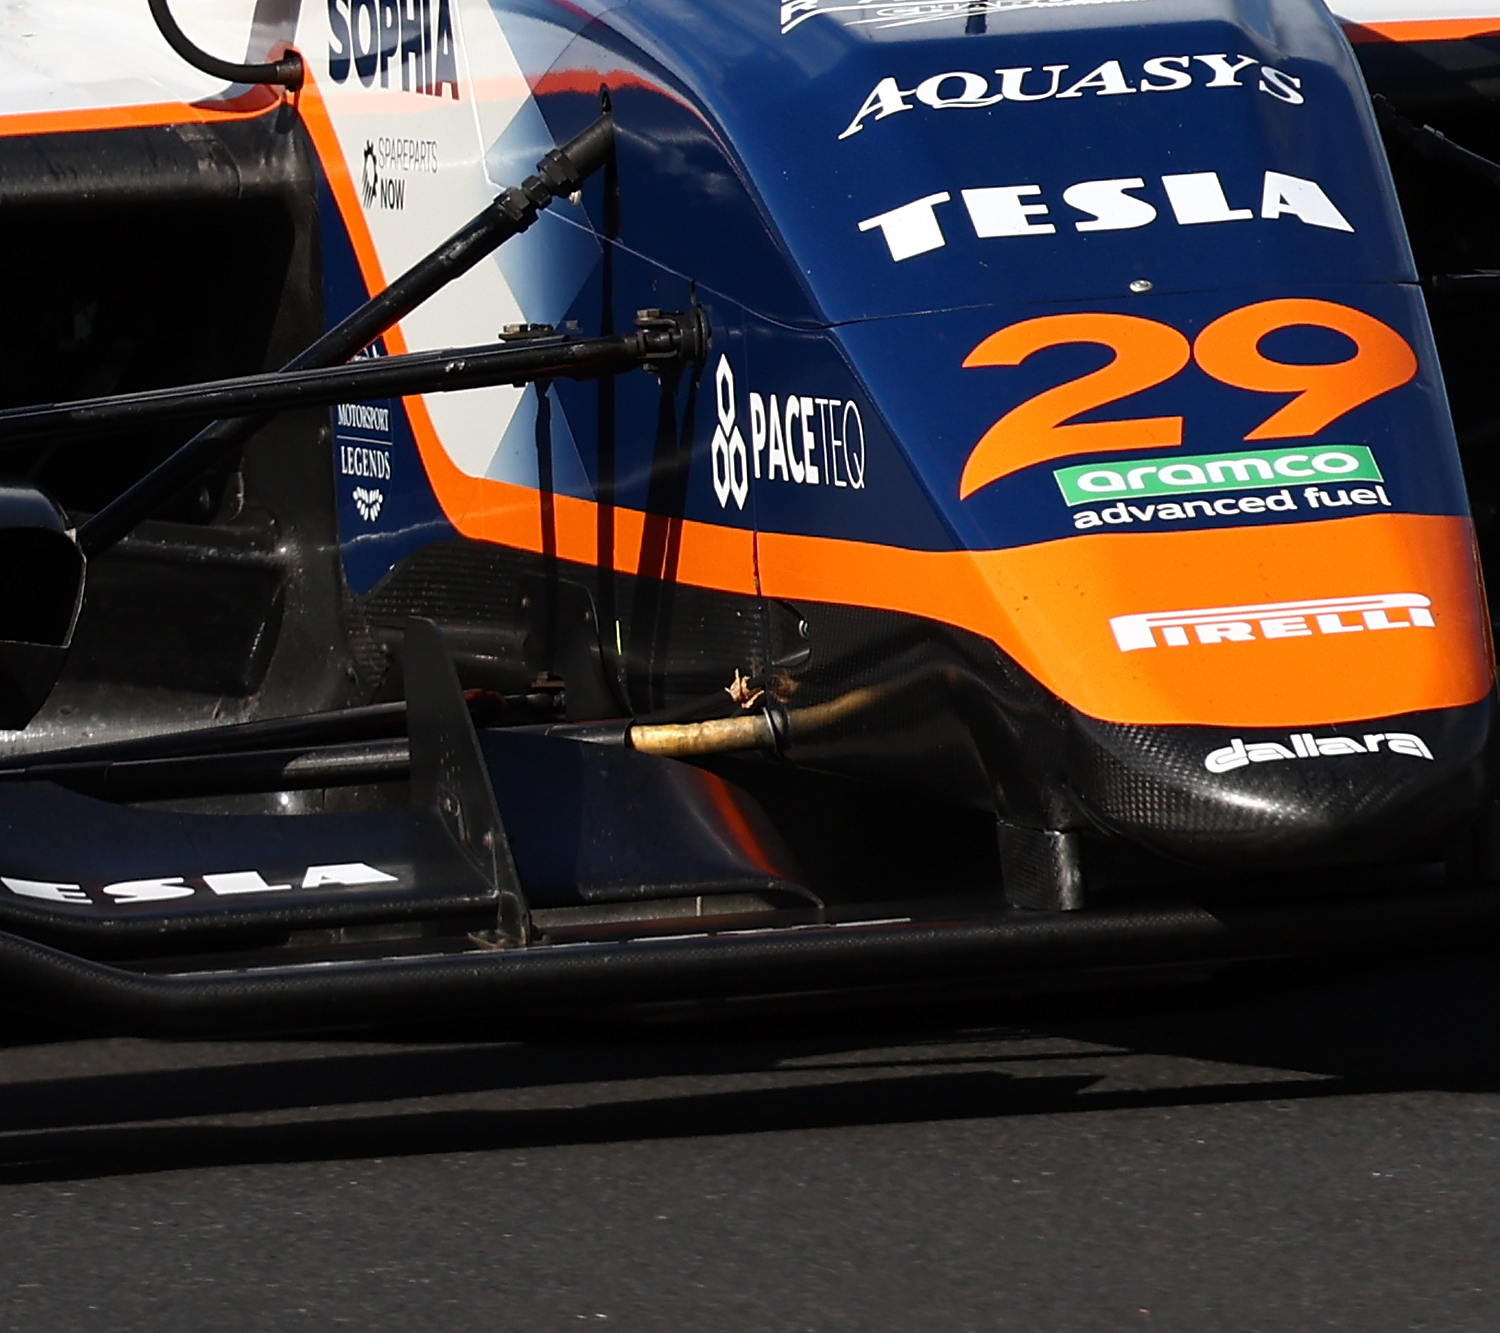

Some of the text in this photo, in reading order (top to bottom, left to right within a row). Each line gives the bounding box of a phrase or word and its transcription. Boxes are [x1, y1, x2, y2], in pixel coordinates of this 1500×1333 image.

[837, 52, 1305, 140] AQUASYS
[378, 137, 438, 174] SPAREPARTS
[379, 179, 406, 211] NOW
[858, 170, 1355, 263] TESLA
[337, 403, 390, 432] MOTORSPORT
[959, 297, 1418, 502] 29
[750, 392, 866, 490] PACETEQ
[340, 446, 391, 480] LEGENDS
[1076, 450, 1360, 493] aramco
[1073, 485, 1392, 529] advanced fuel
[1109, 592, 1436, 653] PIRELLI
[1204, 732, 1434, 774] dallara
